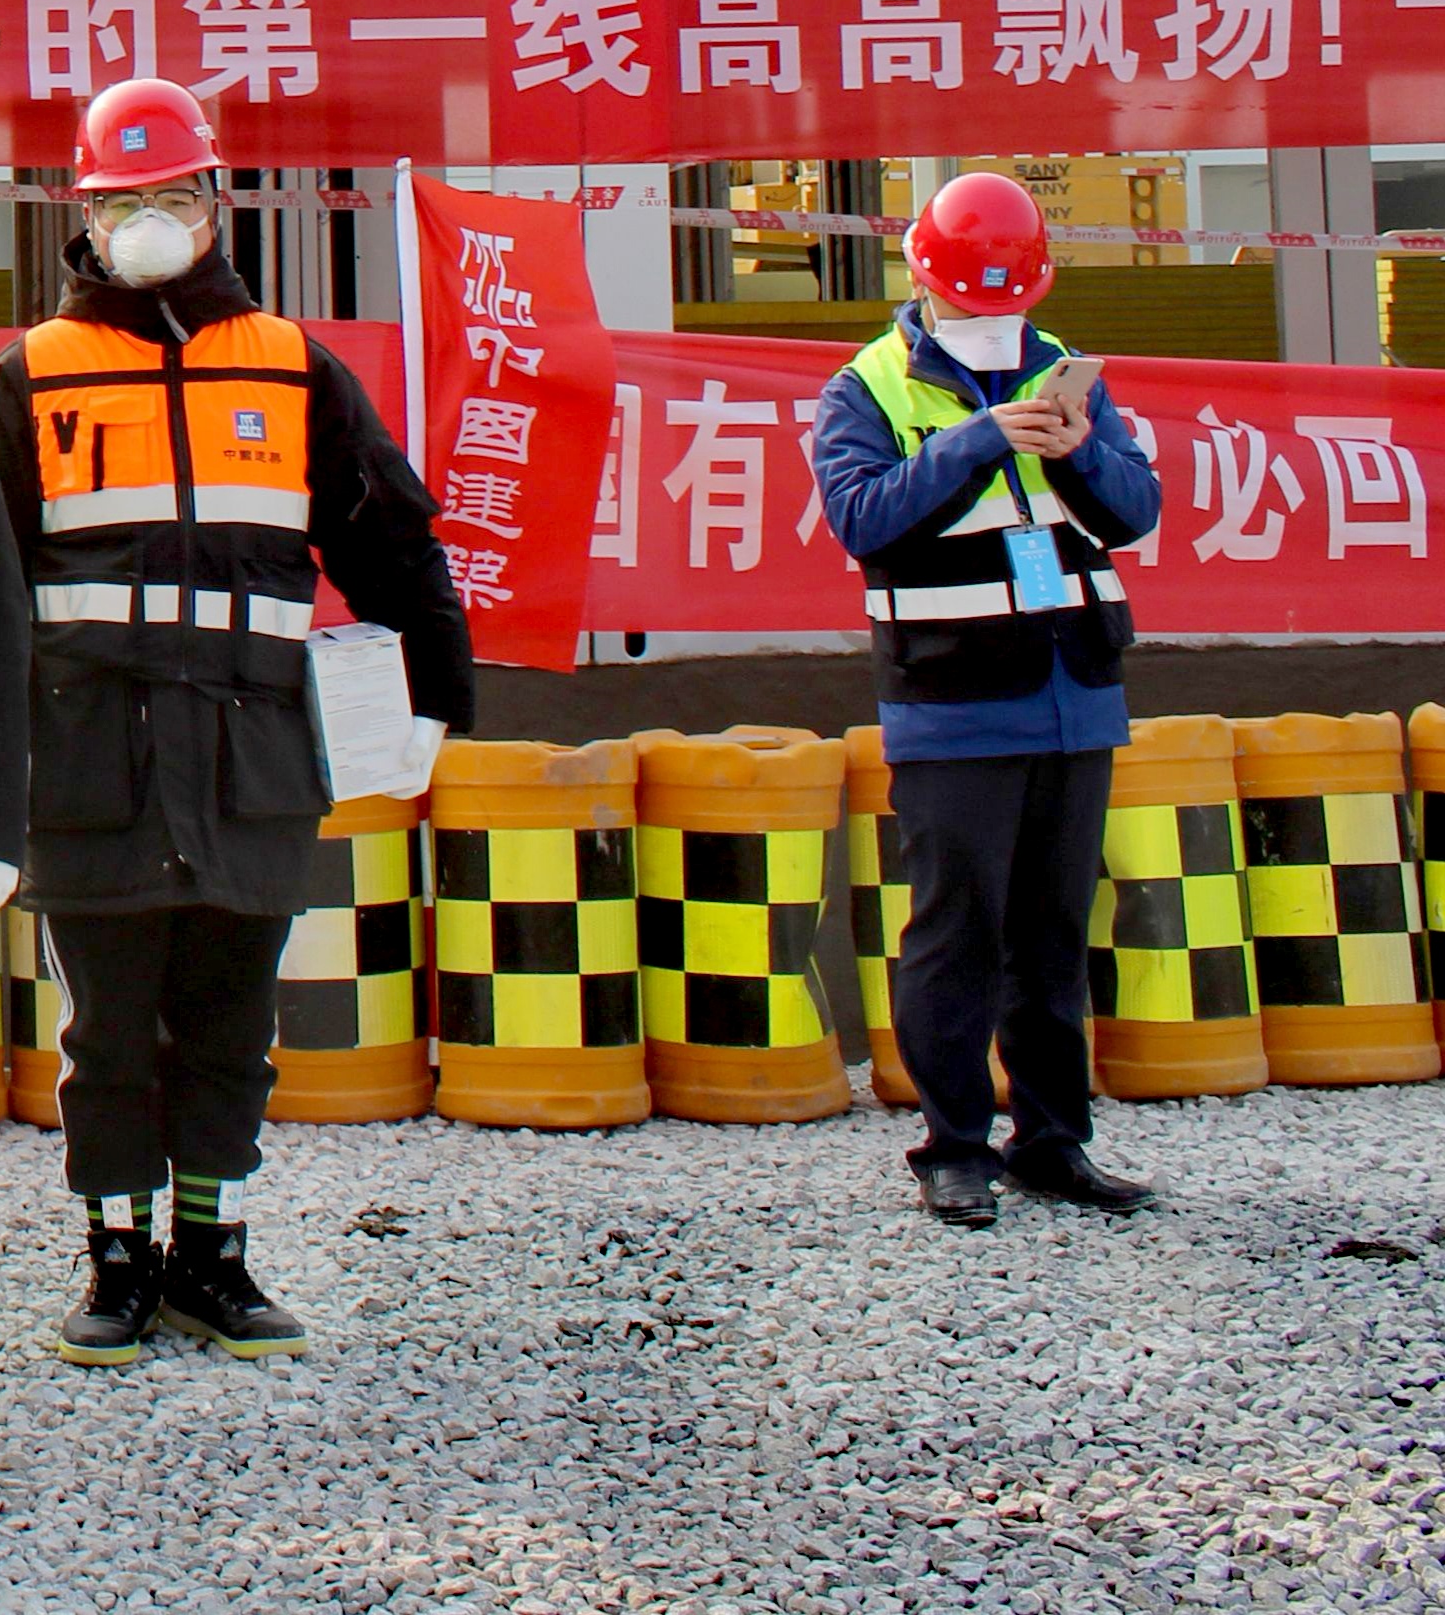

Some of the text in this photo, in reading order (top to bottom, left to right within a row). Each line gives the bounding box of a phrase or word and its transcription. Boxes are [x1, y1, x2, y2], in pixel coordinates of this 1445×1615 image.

[1014, 164, 1070, 177] SANY
[1030, 183, 1071, 196] ANY
[577, 200, 612, 209] AFE
[1045, 207, 1073, 220] NY
[442, 326, 545, 610] 中國建築
